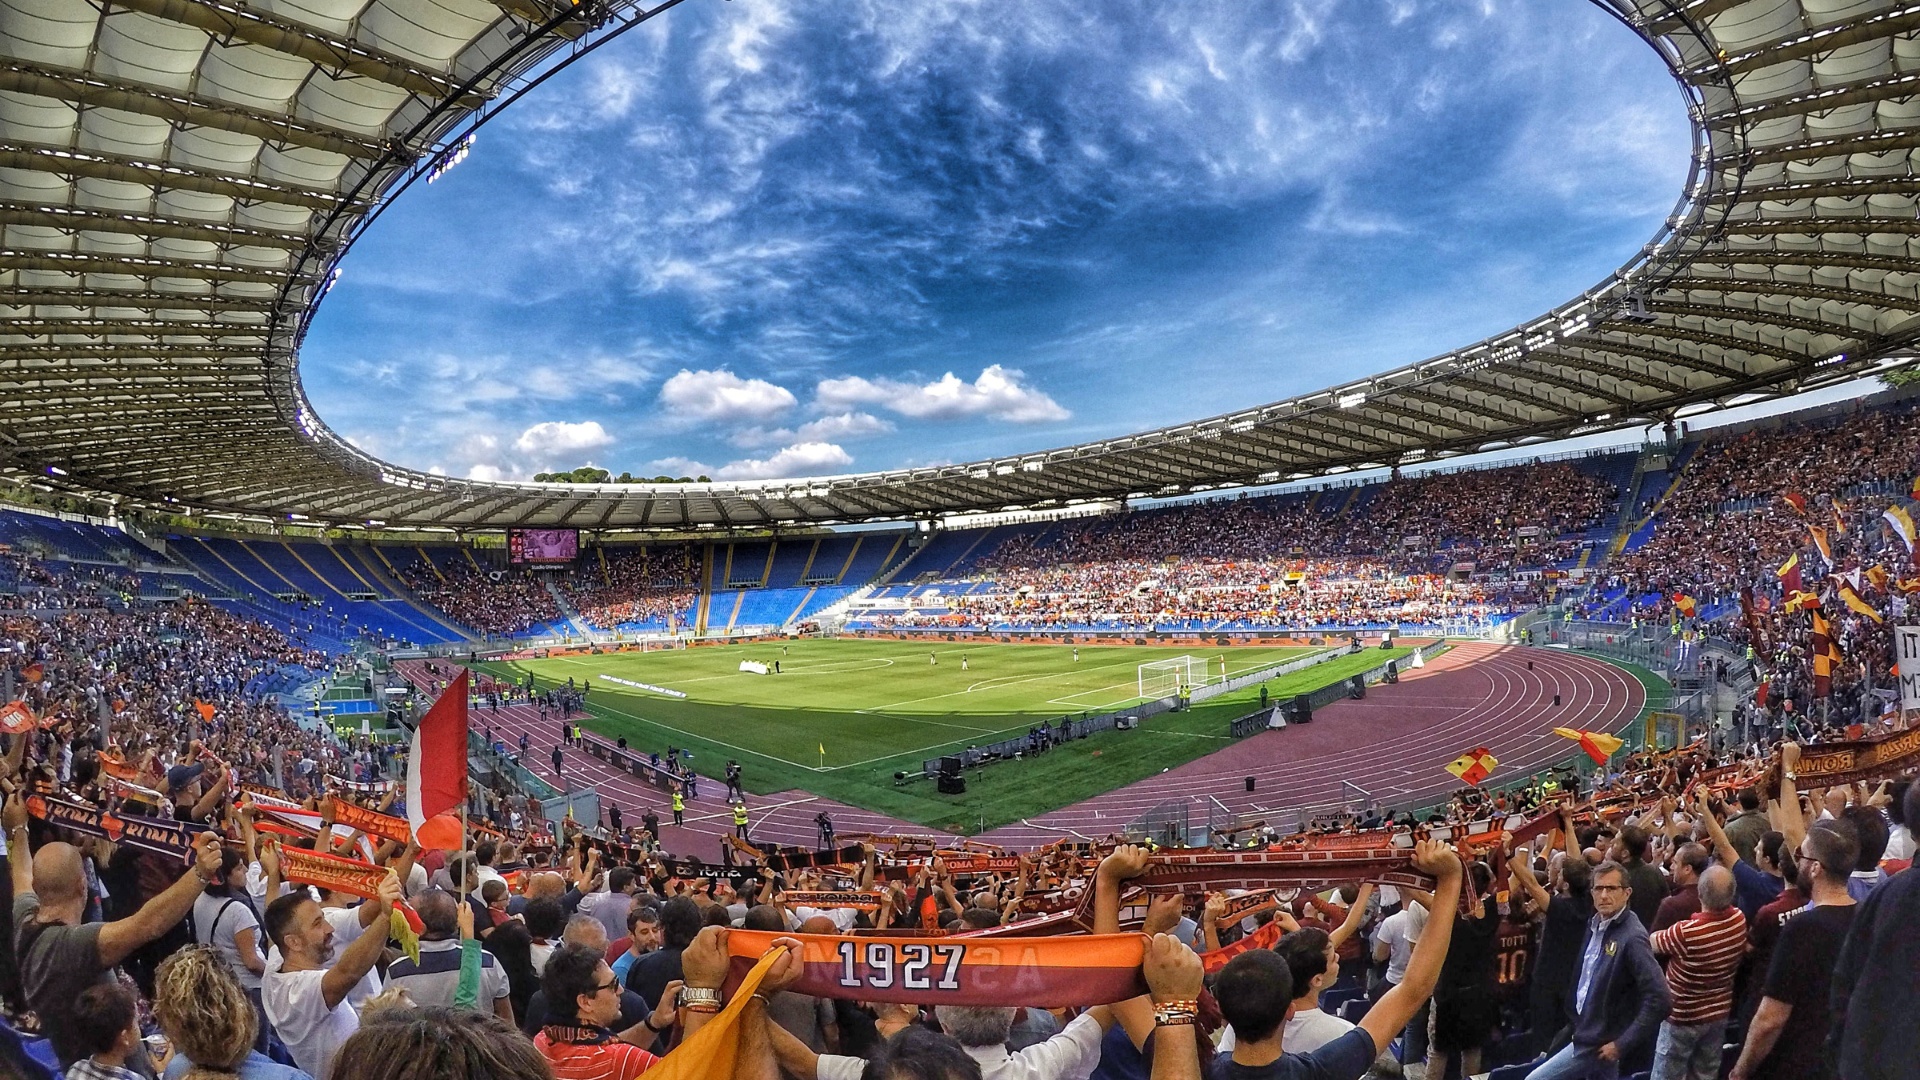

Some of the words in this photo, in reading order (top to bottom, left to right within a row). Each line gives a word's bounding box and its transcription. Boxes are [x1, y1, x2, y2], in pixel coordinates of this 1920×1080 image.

[53, 804, 98, 827] ROMA
[126, 822, 180, 846] ROMA
[989, 860, 1019, 868] ROMA
[816, 893, 873, 902] roma
[1500, 935, 1528, 948] TOTTI
[838, 941, 967, 990] 1927
[1497, 949, 1528, 984] 10
